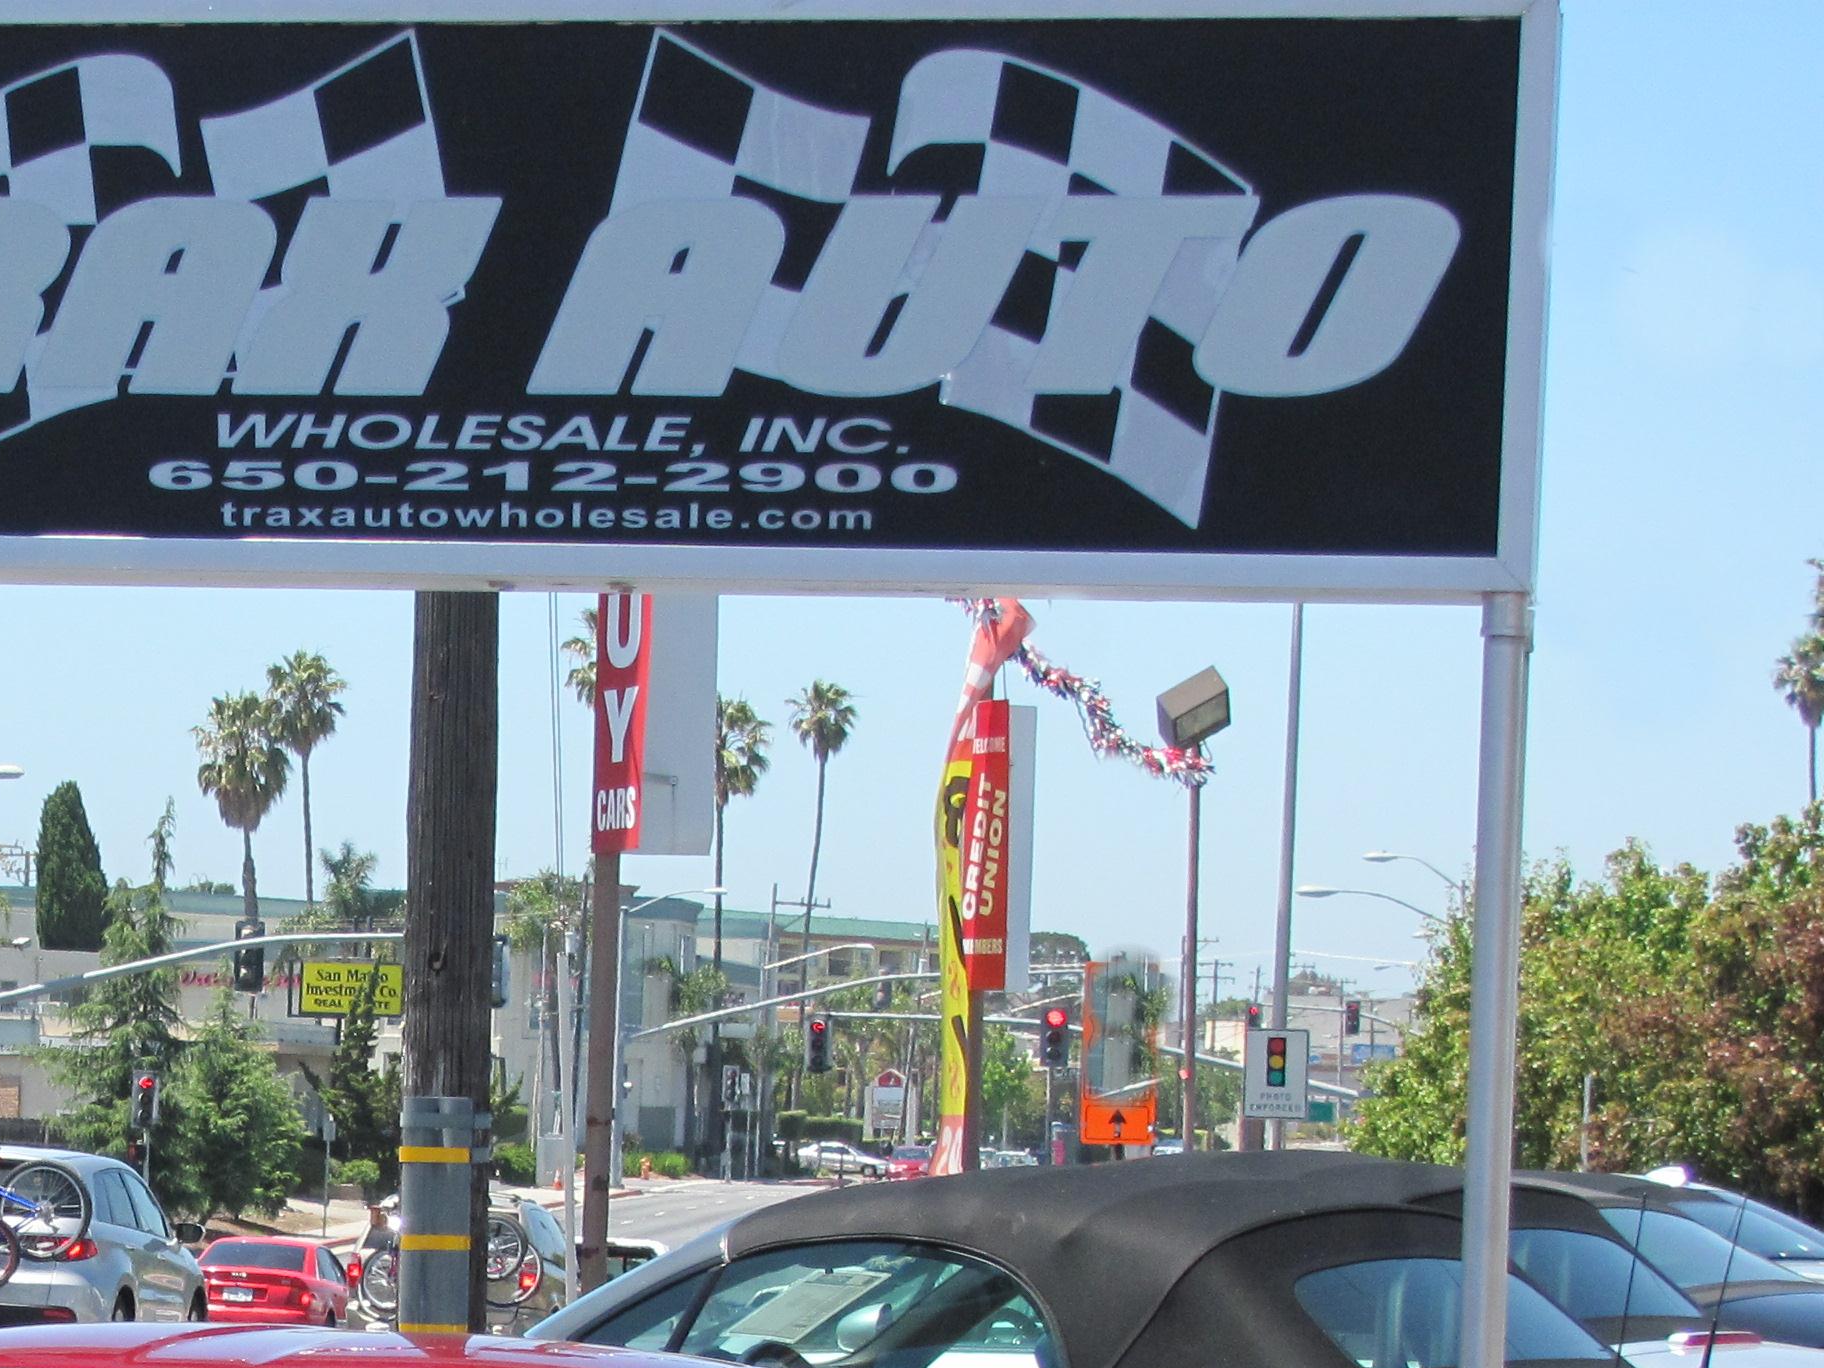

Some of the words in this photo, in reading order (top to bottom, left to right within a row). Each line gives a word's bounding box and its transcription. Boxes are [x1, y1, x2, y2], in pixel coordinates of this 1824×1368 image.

[526, 194, 1462, 398] AUTO
[216, 413, 706, 458] WHOLESALE,
[738, 416, 911, 455] INC.
[147, 460, 959, 494] 650-212-2900
[220, 501, 874, 530] traxautowholesale.com
[604, 594, 642, 763] UY
[596, 786, 637, 832] CARS
[962, 773, 992, 921] CREDIT
[979, 789, 1007, 917] UNION
[317, 968, 341, 982] San
[347, 969, 389, 983] Mao
